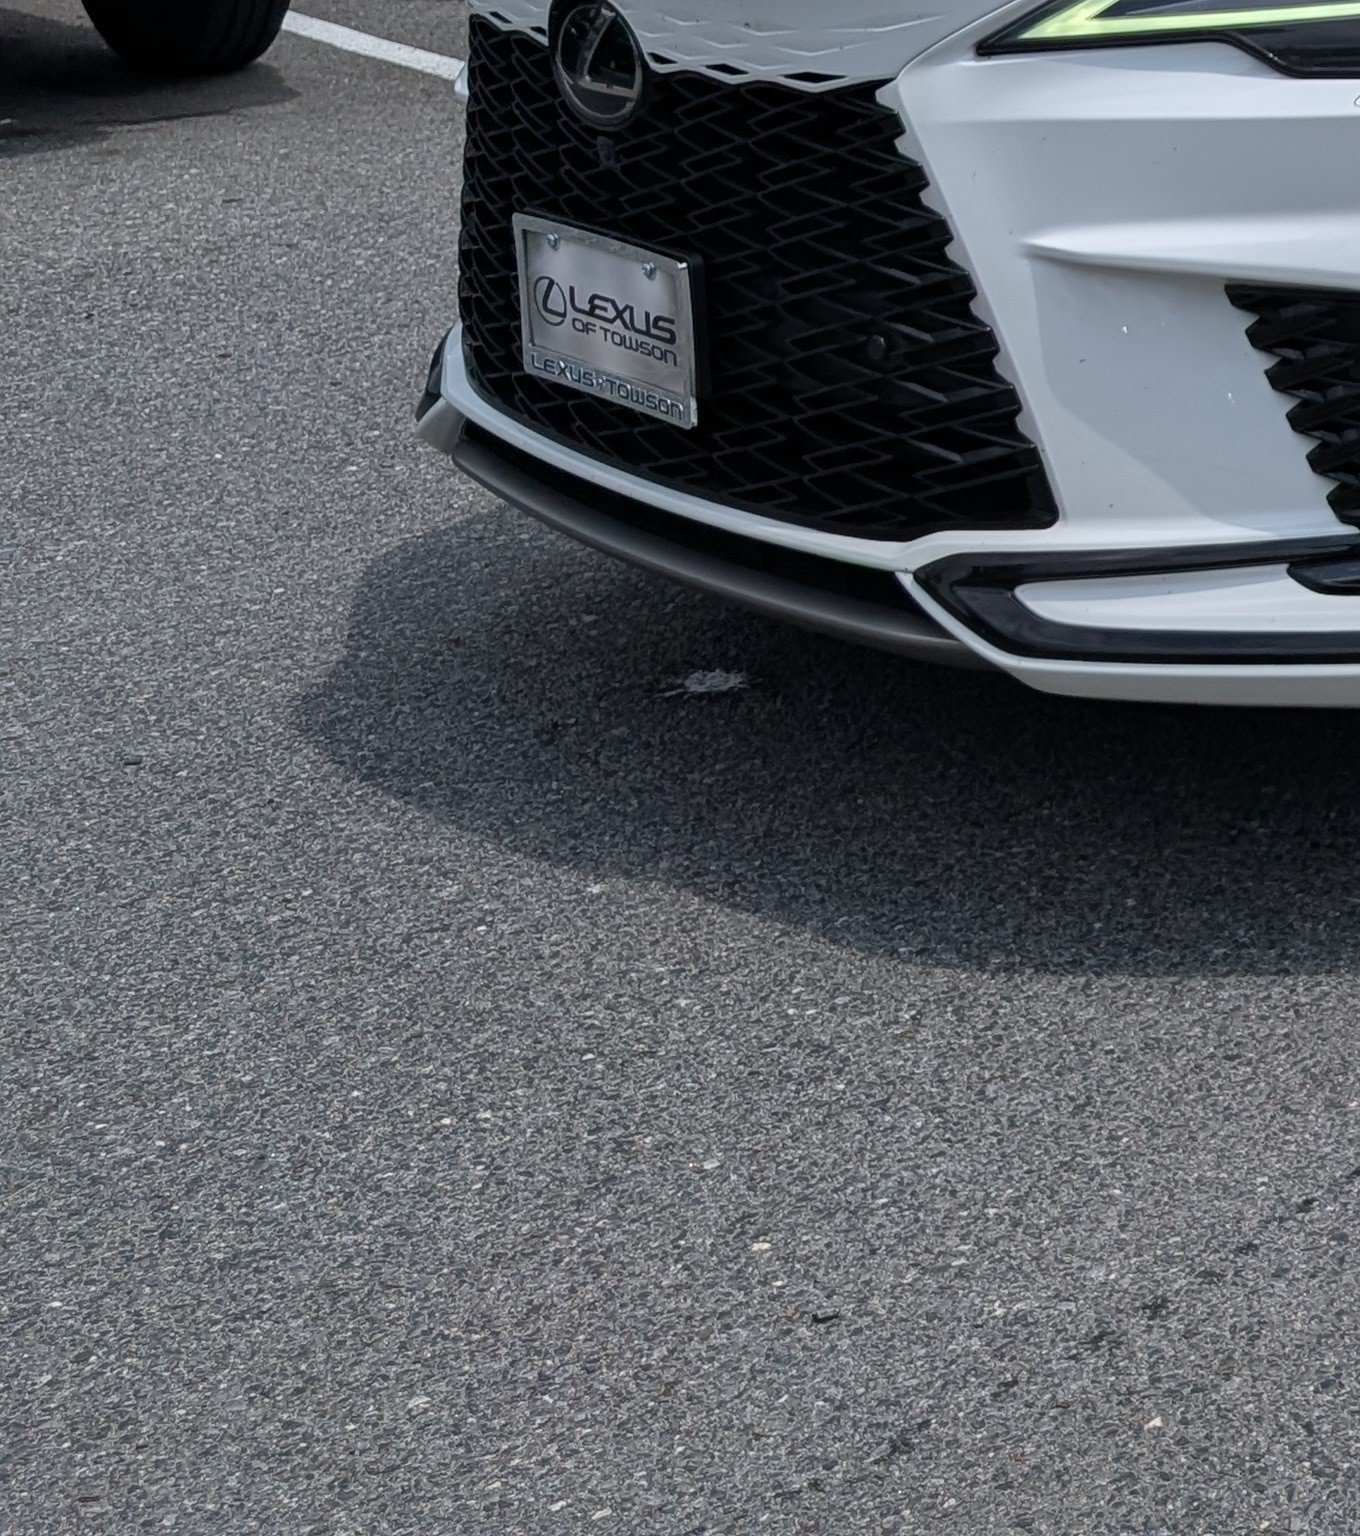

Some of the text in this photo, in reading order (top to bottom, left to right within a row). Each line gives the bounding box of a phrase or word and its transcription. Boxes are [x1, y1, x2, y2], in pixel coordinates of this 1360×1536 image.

[569, 285, 677, 346] LEXUS
[572, 318, 597, 334] OF
[531, 354, 595, 388] LEXUS
